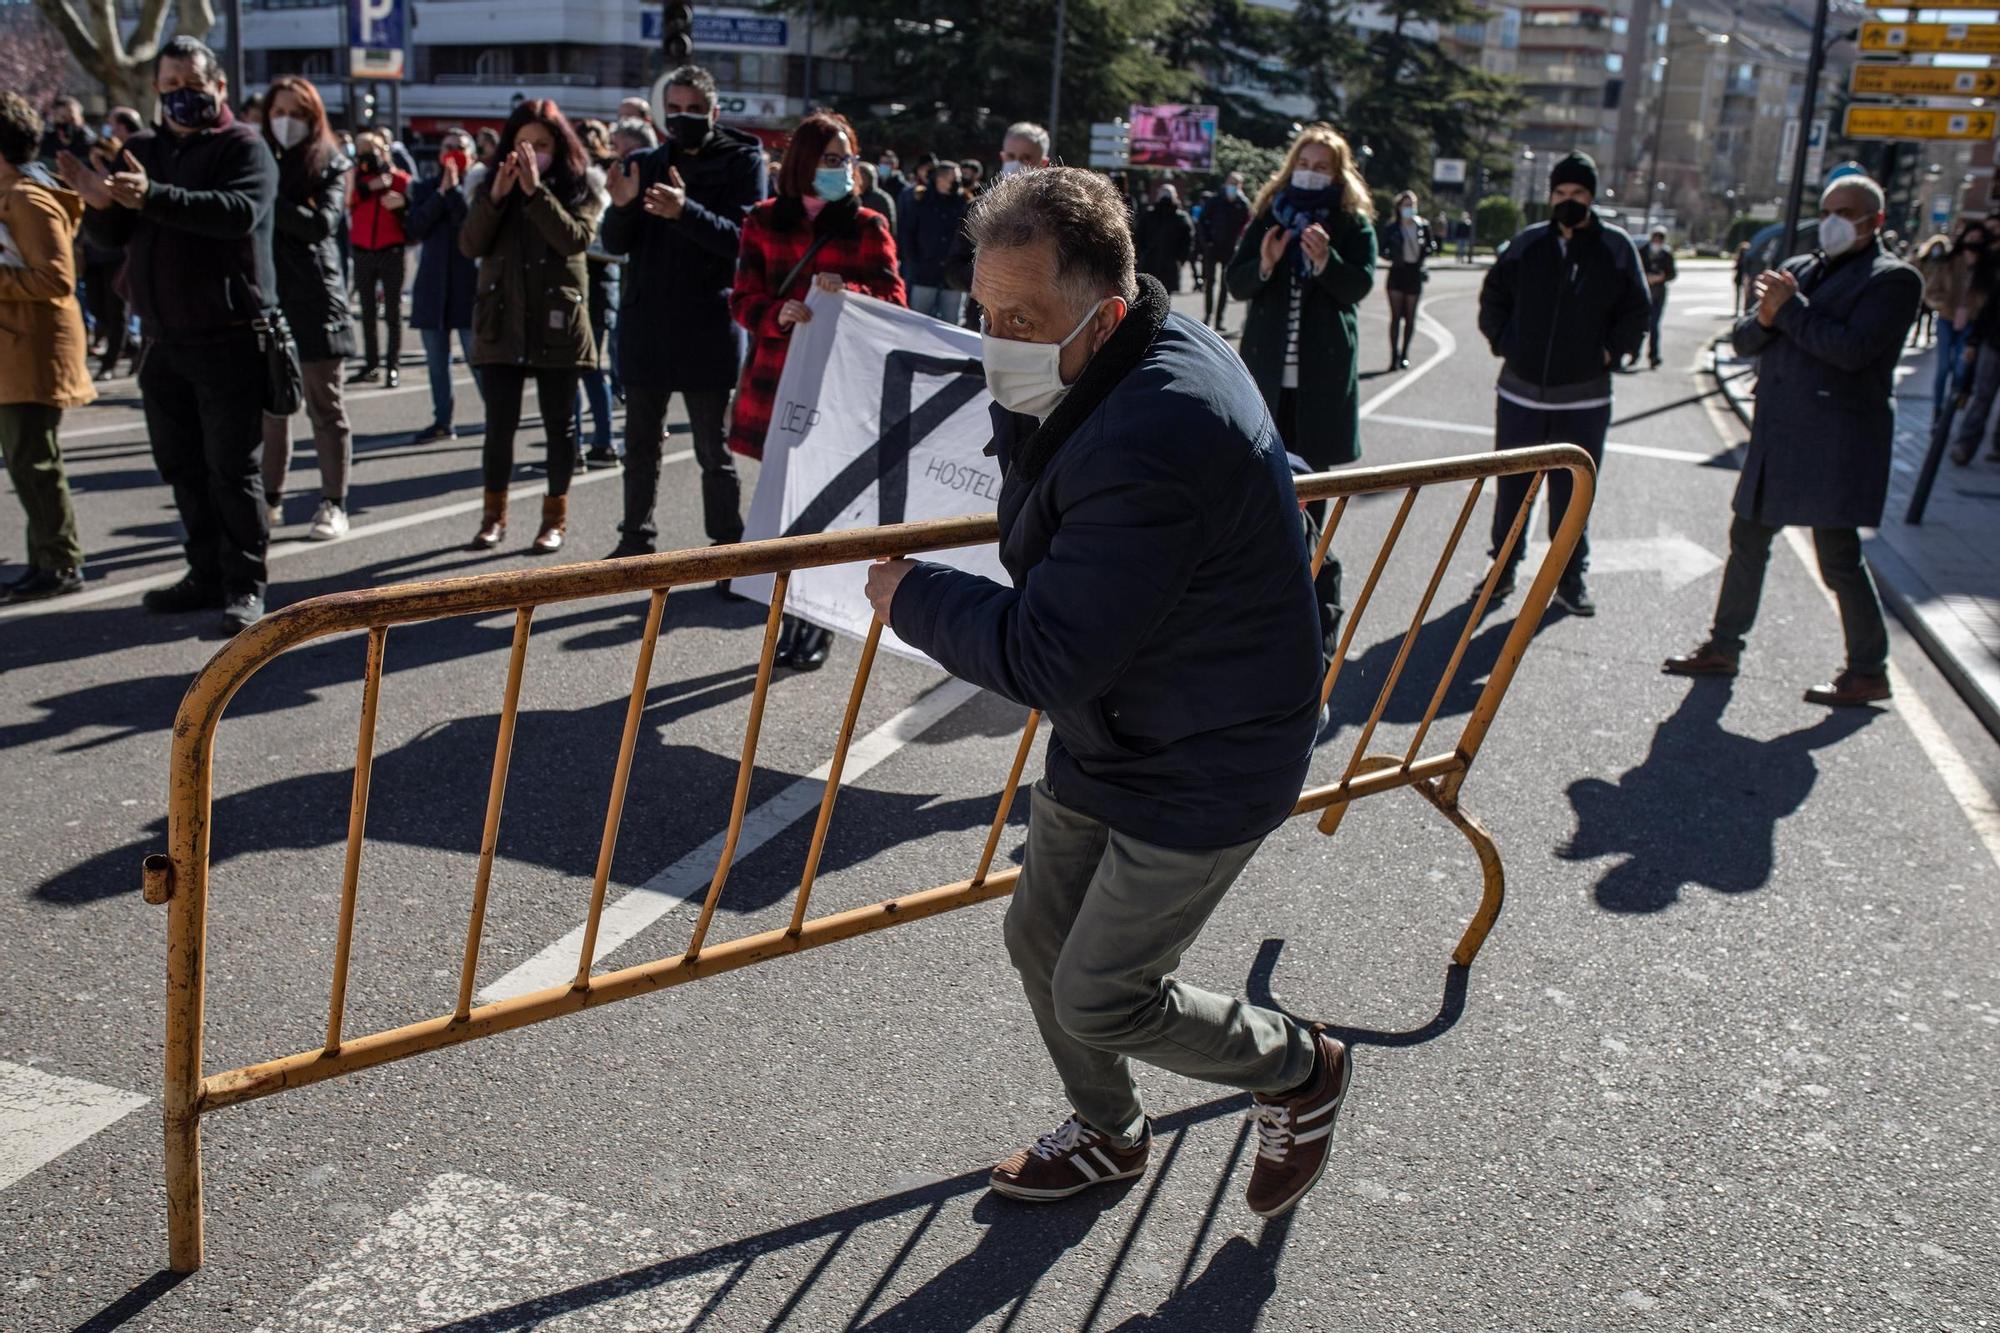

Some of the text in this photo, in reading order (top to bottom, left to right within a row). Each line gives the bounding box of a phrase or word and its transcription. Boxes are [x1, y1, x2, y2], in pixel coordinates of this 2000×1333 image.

[361, 0, 393, 43] P
[780, 401, 821, 434] DEP
[925, 457, 1000, 502] HOSTEL
